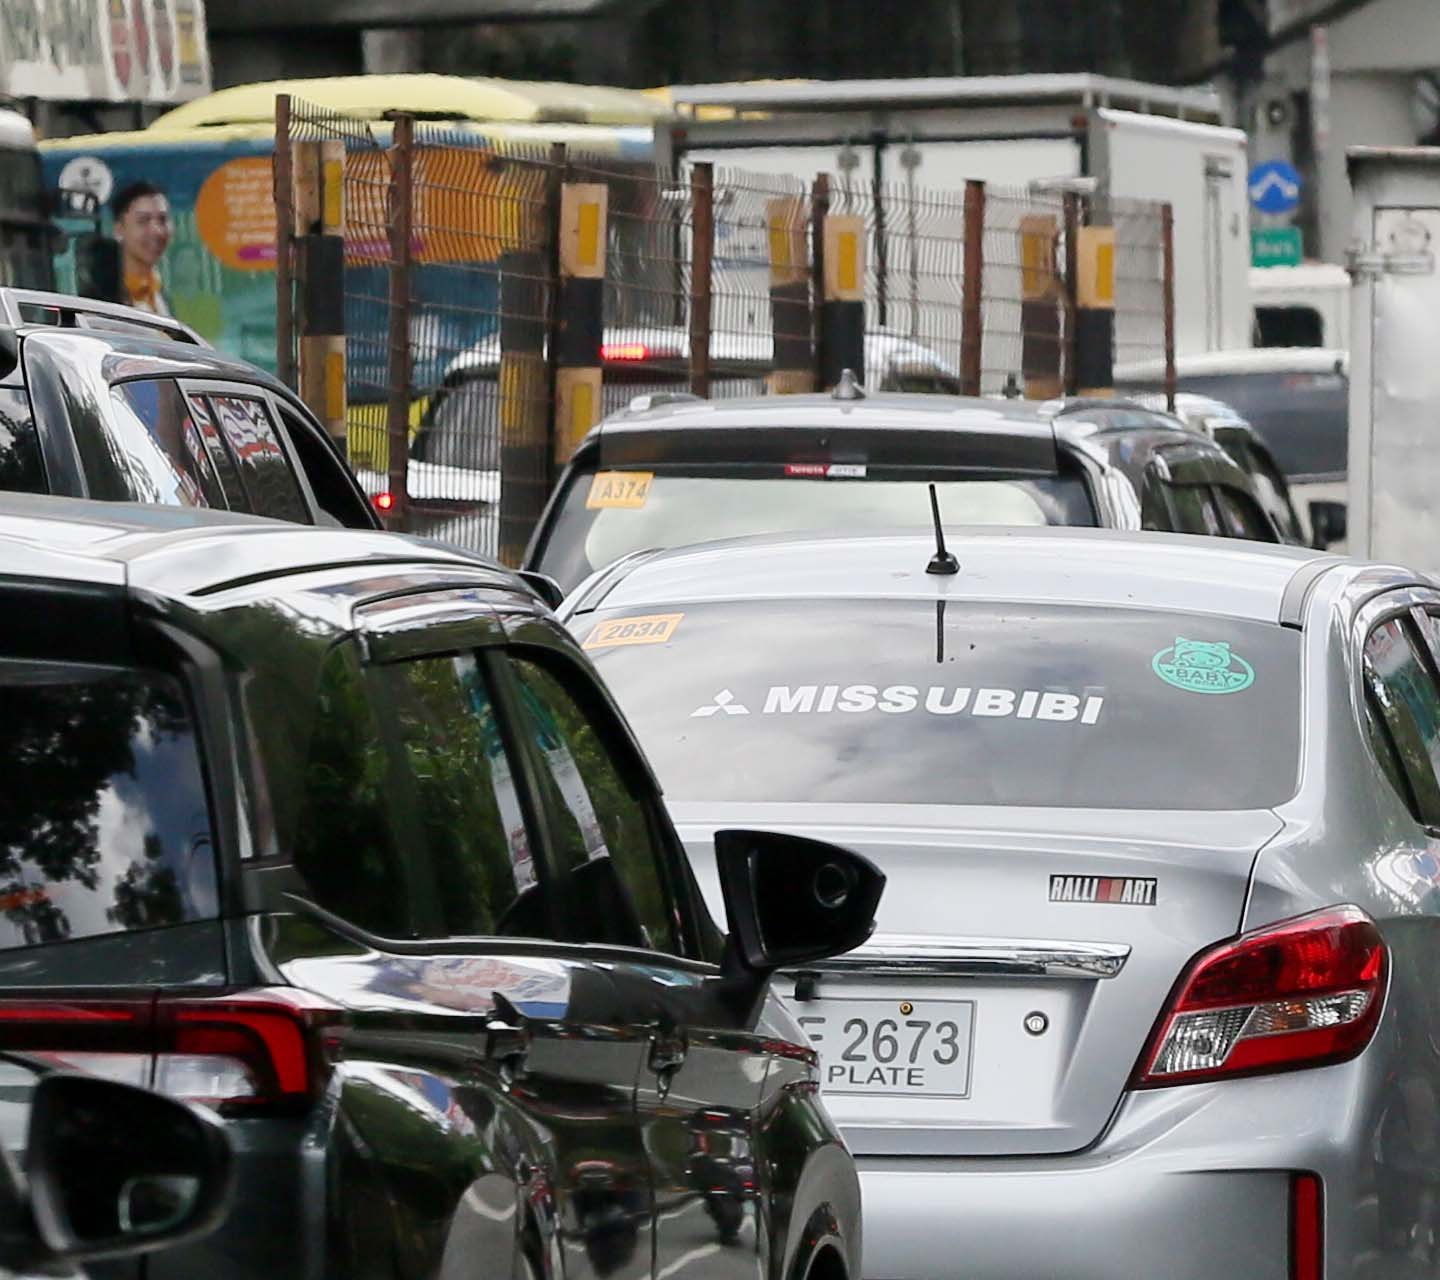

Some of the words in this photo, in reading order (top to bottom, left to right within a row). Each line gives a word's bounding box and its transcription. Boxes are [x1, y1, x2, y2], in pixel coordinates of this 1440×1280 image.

[604, 620, 670, 640] 283A
[1175, 667, 1233, 684] BABY
[762, 684, 1105, 726] MISSUBIBI
[841, 1017, 960, 1066] 2673
[827, 1065, 926, 1087] PLATE
